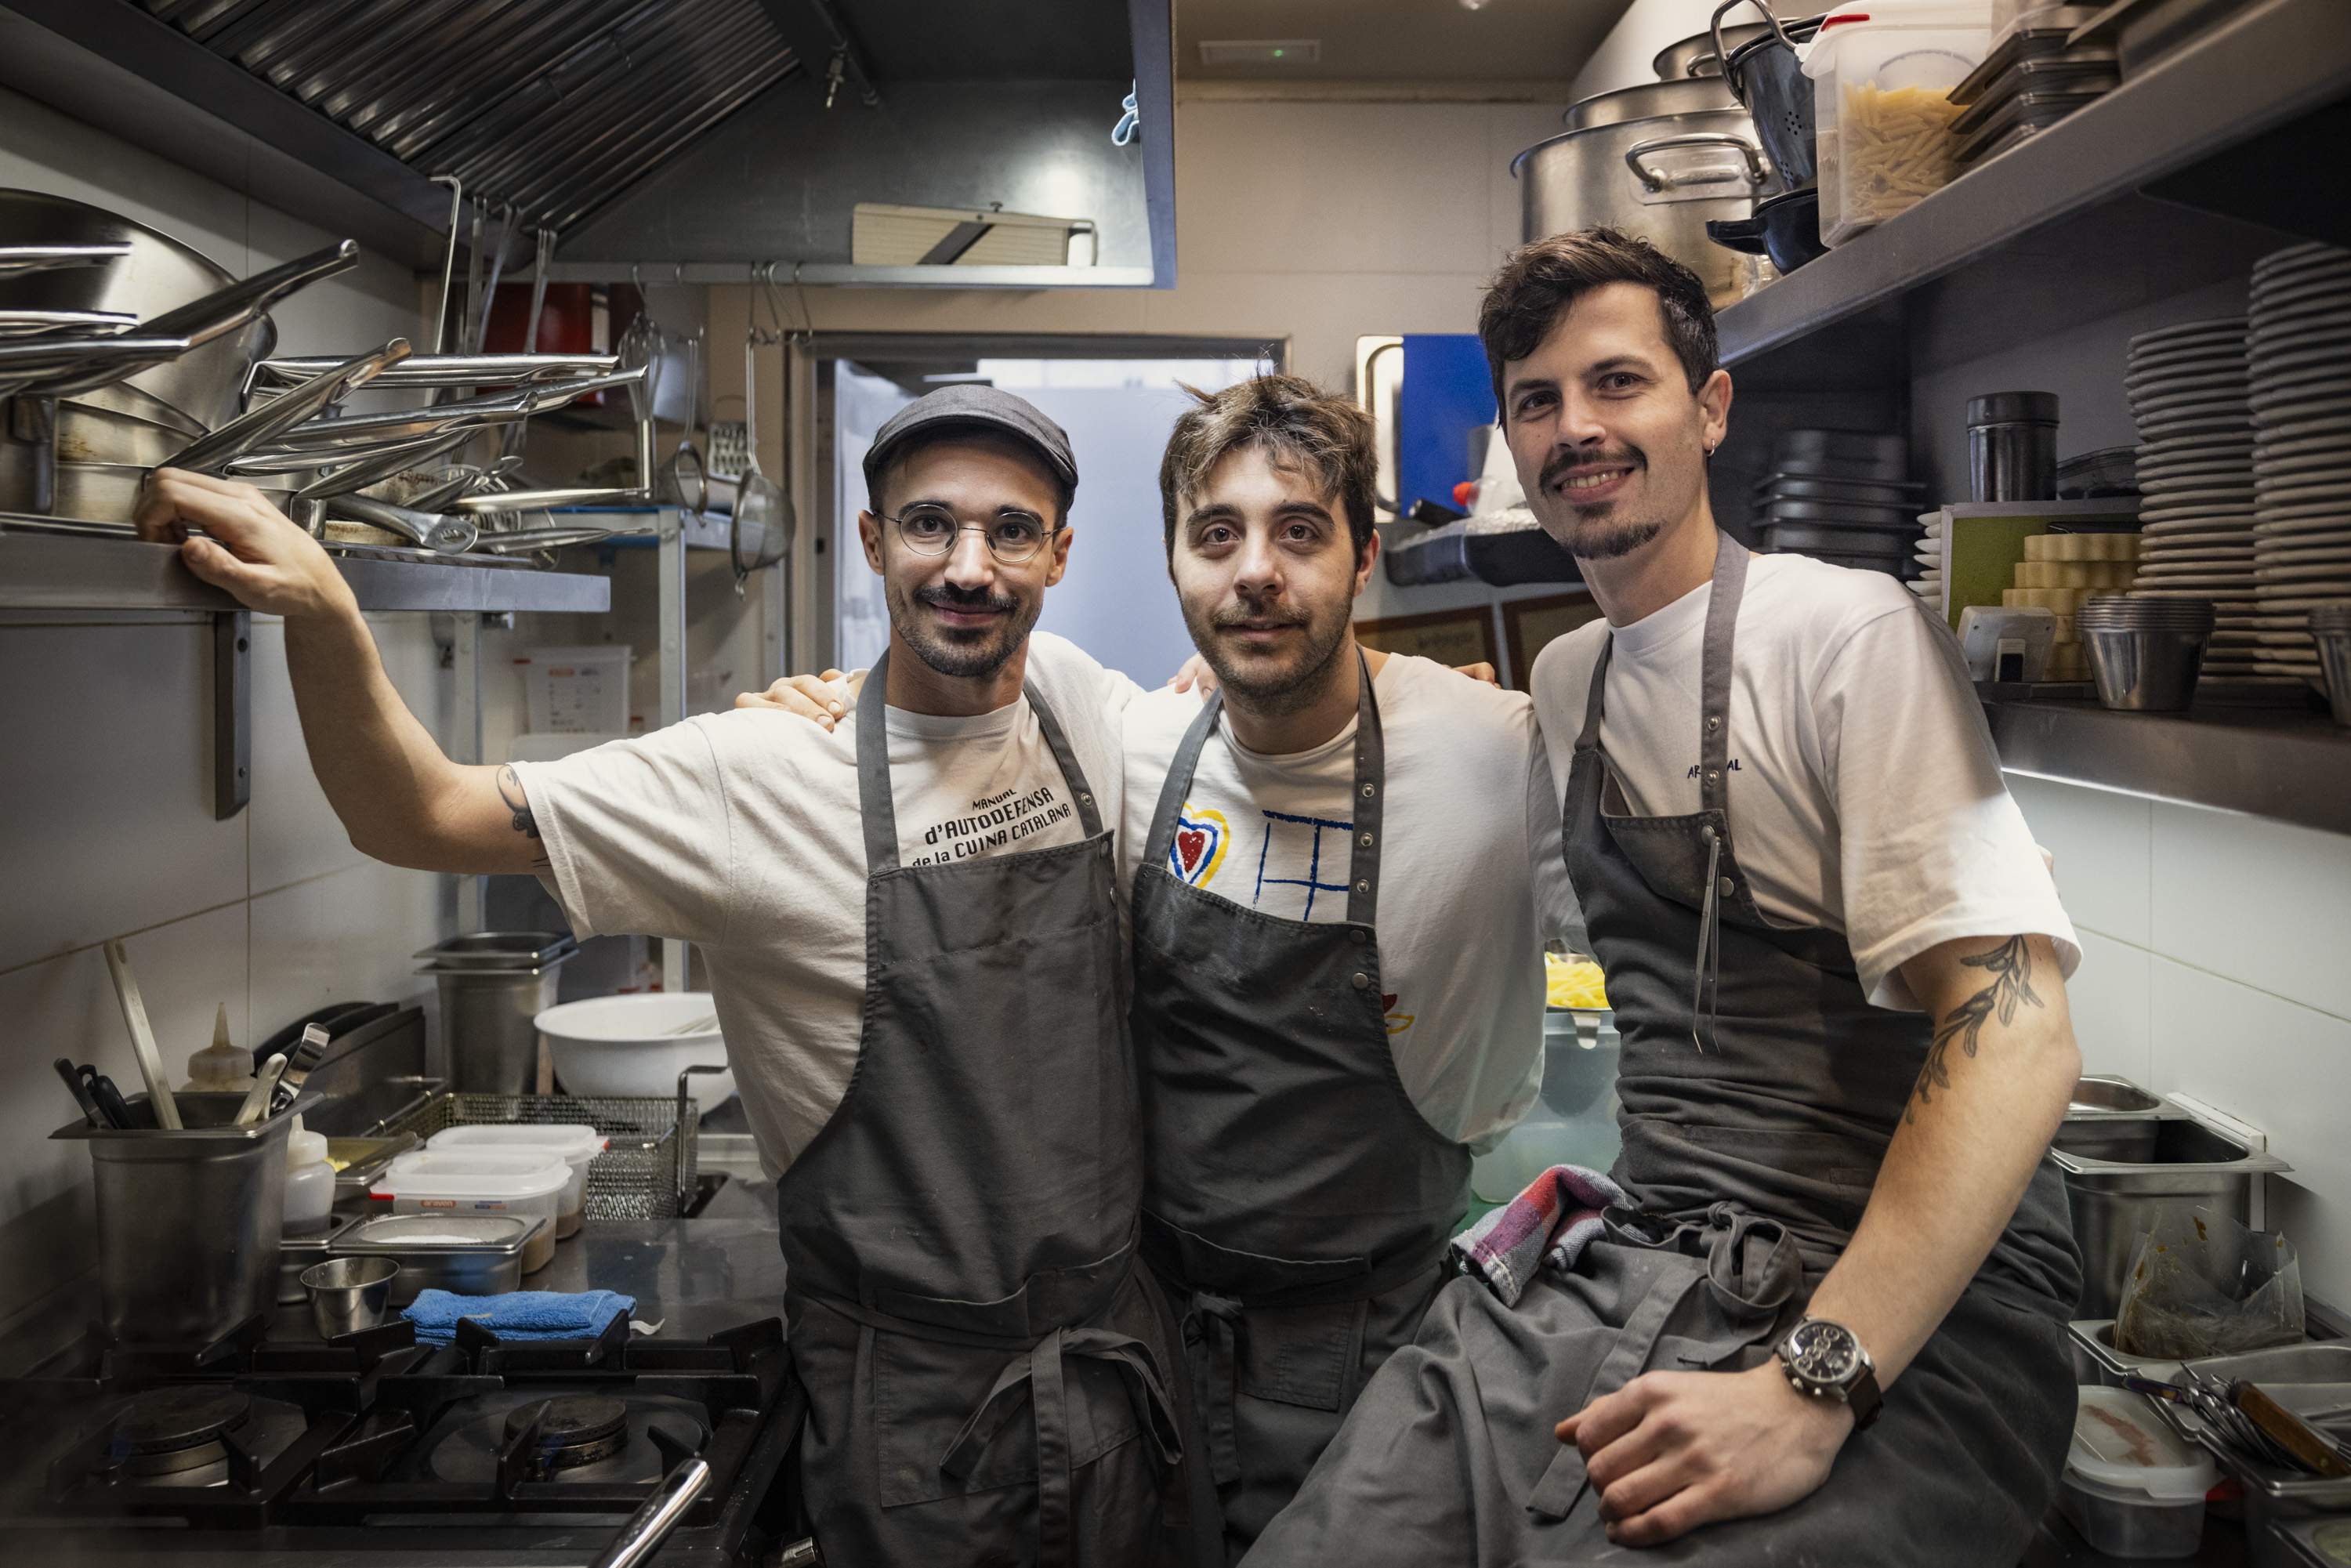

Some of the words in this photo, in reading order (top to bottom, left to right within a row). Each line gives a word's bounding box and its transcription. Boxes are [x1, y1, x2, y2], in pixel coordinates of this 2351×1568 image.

[972, 788, 1016, 811] MANUAL
[935, 851, 951, 864] la
[955, 829, 1007, 858] CUINA
[1011, 802, 1072, 840] CATALANA
